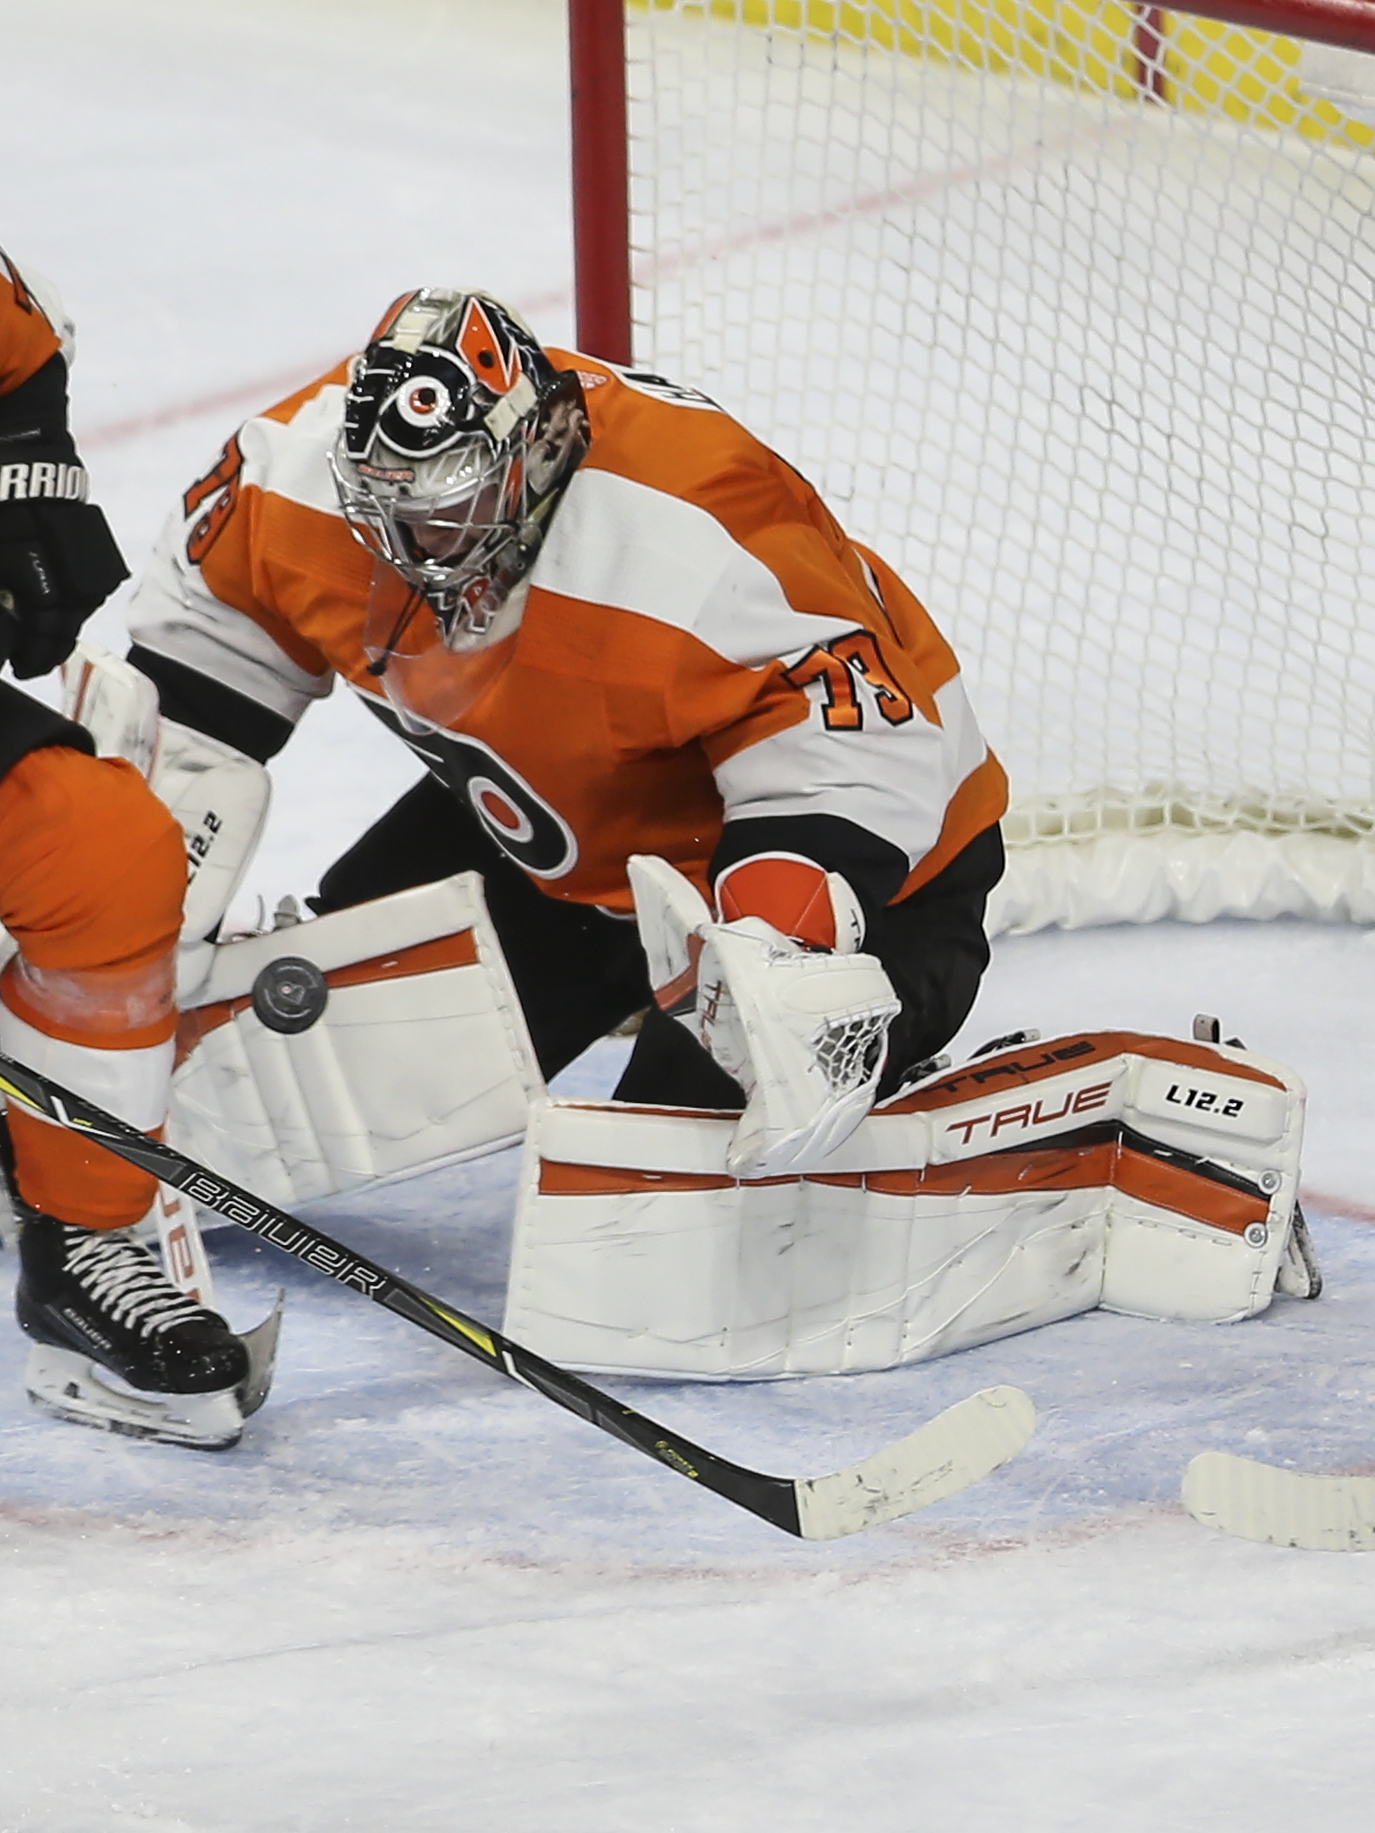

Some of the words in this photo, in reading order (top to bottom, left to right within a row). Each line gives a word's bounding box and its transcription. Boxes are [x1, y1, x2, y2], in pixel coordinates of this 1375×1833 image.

[779, 628, 914, 731] 79
[945, 1080, 1114, 1145] TRUE
[1165, 1083, 1244, 1119] L12.2
[178, 1170, 389, 1300] BAUER
